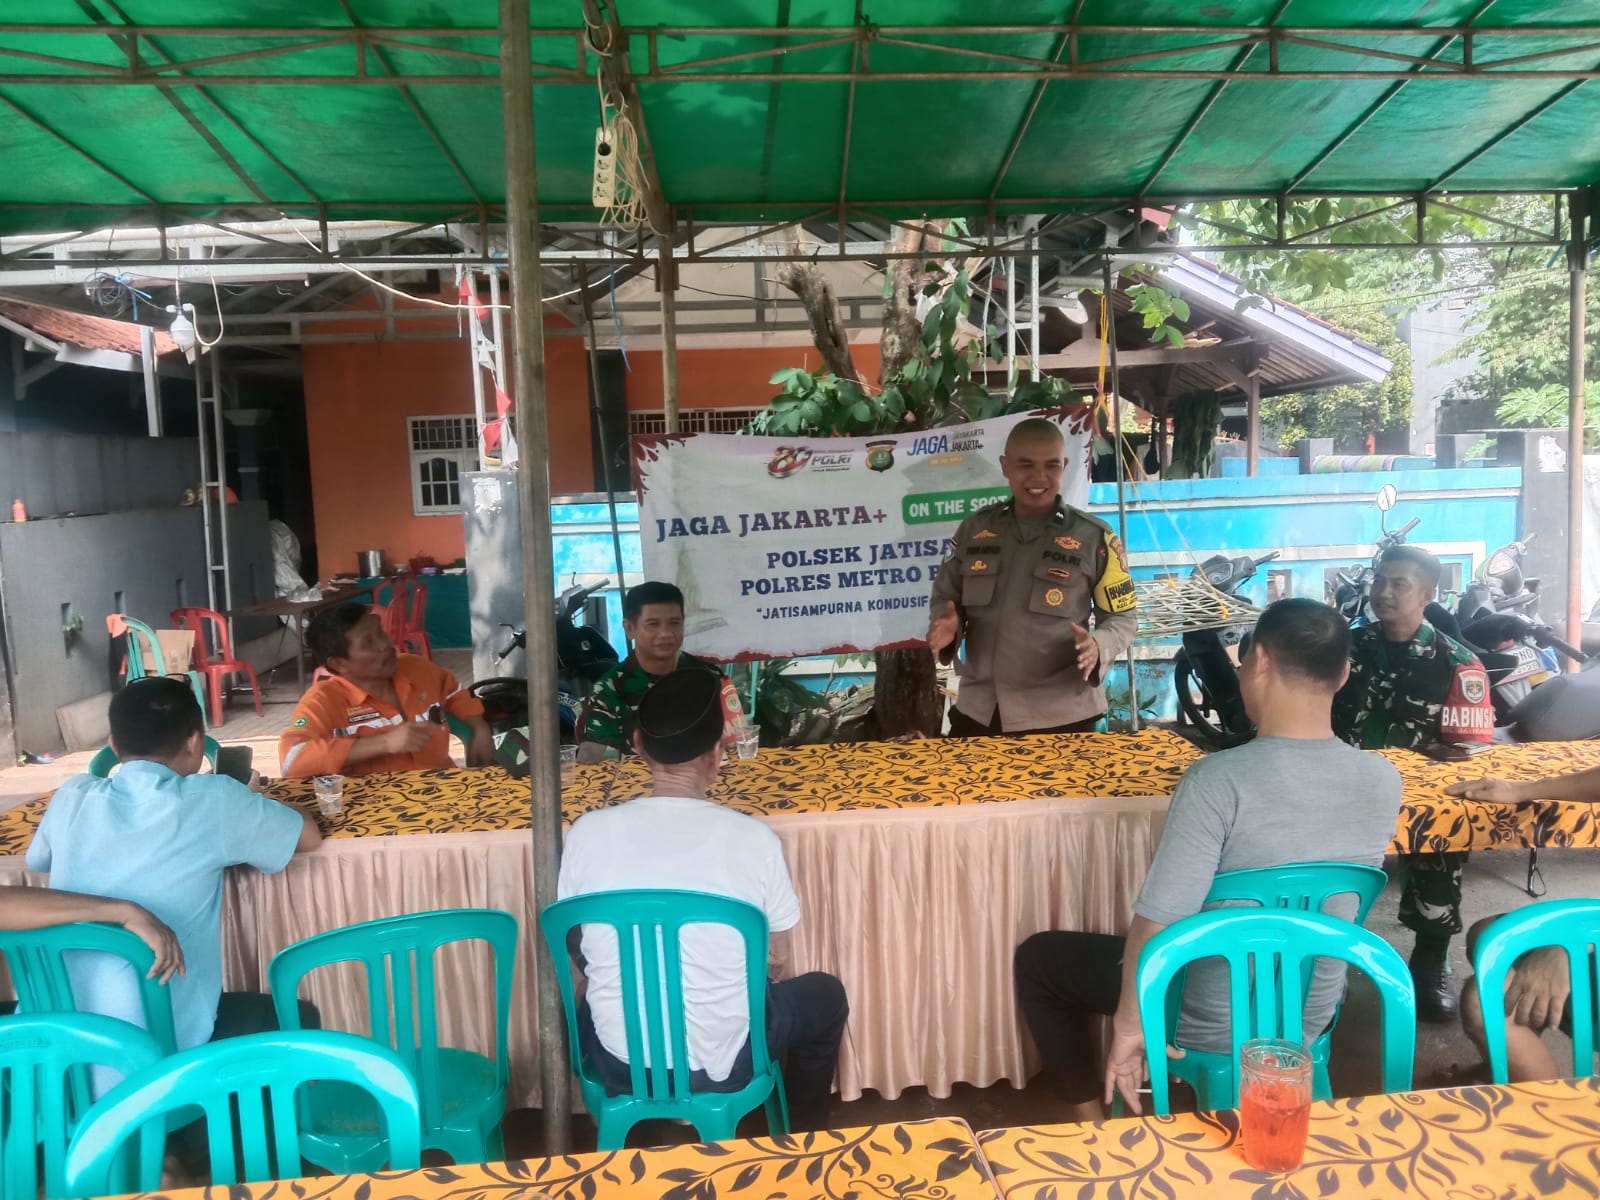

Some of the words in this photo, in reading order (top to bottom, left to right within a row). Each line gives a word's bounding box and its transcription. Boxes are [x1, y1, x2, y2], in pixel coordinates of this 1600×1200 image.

[906, 434, 948, 456] JAGA
[811, 453, 852, 466] POLRI
[909, 502, 930, 518] ON
[934, 499, 965, 516] THE
[656, 515, 731, 543] JAGA
[738, 505, 888, 538] JAKARTA+
[766, 546, 863, 569] POLSEK
[1043, 550, 1081, 567] POLRI
[740, 573, 831, 596] POLRES
[837, 566, 923, 589] METRO
[868, 595, 929, 612] KONDUSIF
